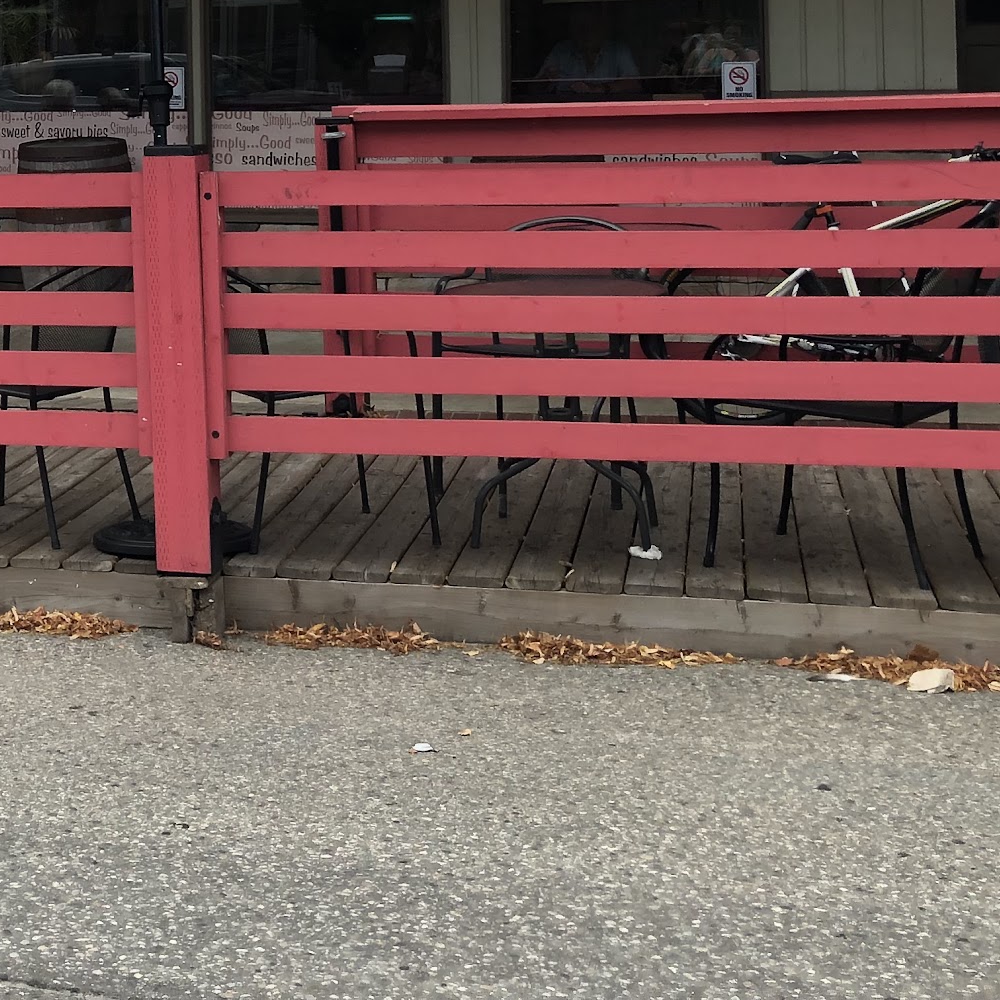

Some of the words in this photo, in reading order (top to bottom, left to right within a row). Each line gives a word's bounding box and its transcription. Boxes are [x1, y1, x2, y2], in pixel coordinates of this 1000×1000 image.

[1, 125, 30, 138] sweet
[34, 122, 44, 138] &
[236, 122, 260, 133] Soups
[242, 152, 317, 166] sandwiches
